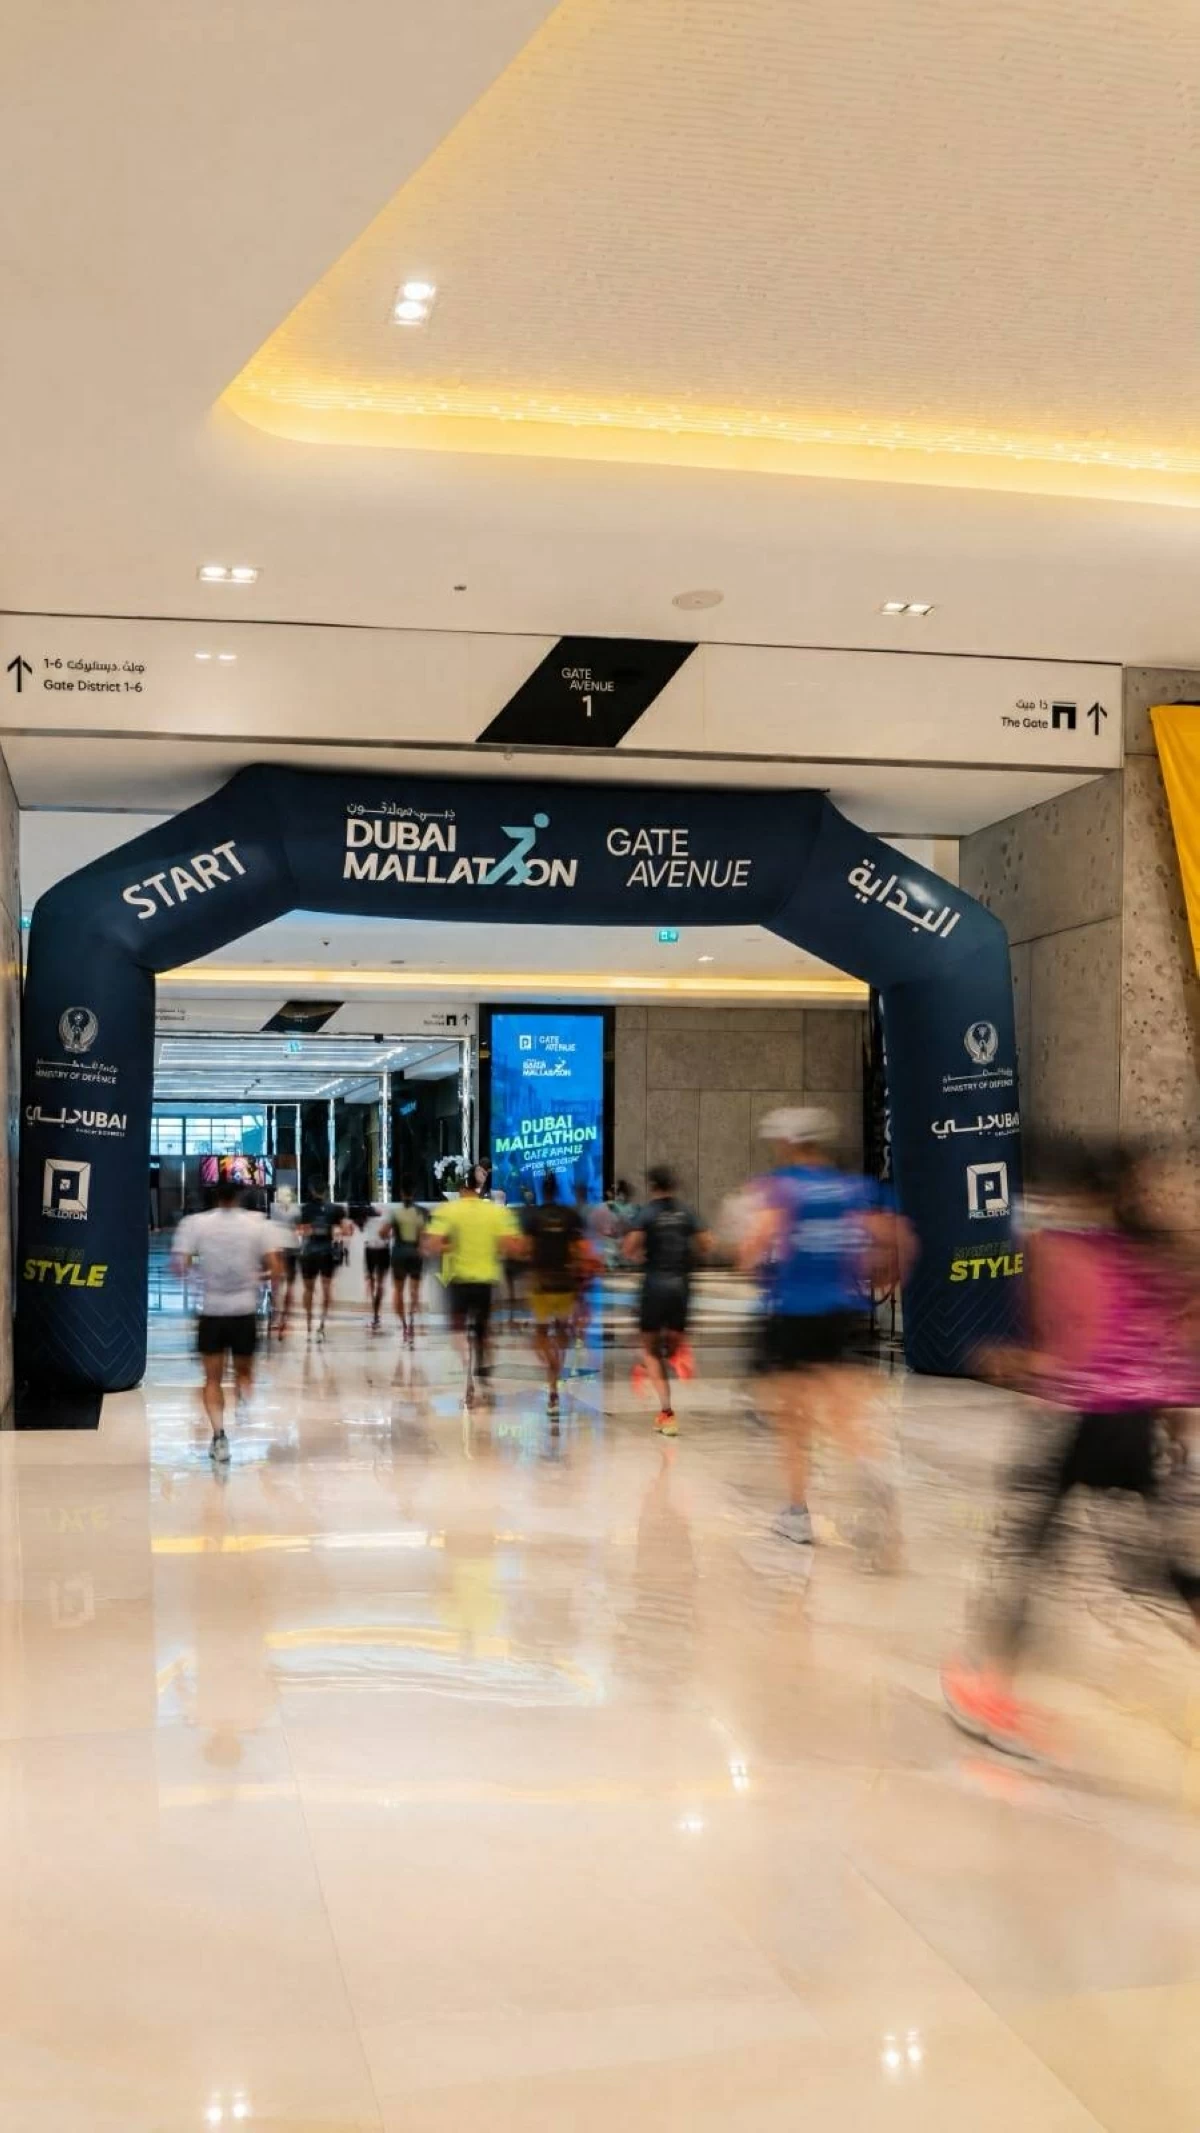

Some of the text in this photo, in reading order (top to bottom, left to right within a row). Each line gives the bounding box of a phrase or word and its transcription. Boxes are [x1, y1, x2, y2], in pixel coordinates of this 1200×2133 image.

[43, 658, 63, 669] 1-6
[561, 667, 592, 680] GATE
[43, 679, 143, 693] Gate District 1-6
[569, 680, 615, 692] AVENUE
[582, 694, 592, 717] 1
[1001, 716, 1048, 729] The Gate
[346, 818, 457, 852] DUBAI
[606, 827, 689, 857] GATE
[122, 840, 247, 920] START
[343, 851, 578, 887] MALLATON
[626, 859, 752, 888] AVENUE
[847, 858, 960, 938] البداية
[521, 1115, 572, 1135] DUBAI
[495, 1126, 597, 1153] MALLATHON
[23, 1258, 108, 1287] STYLE
[949, 1252, 1024, 1282] STYLE
